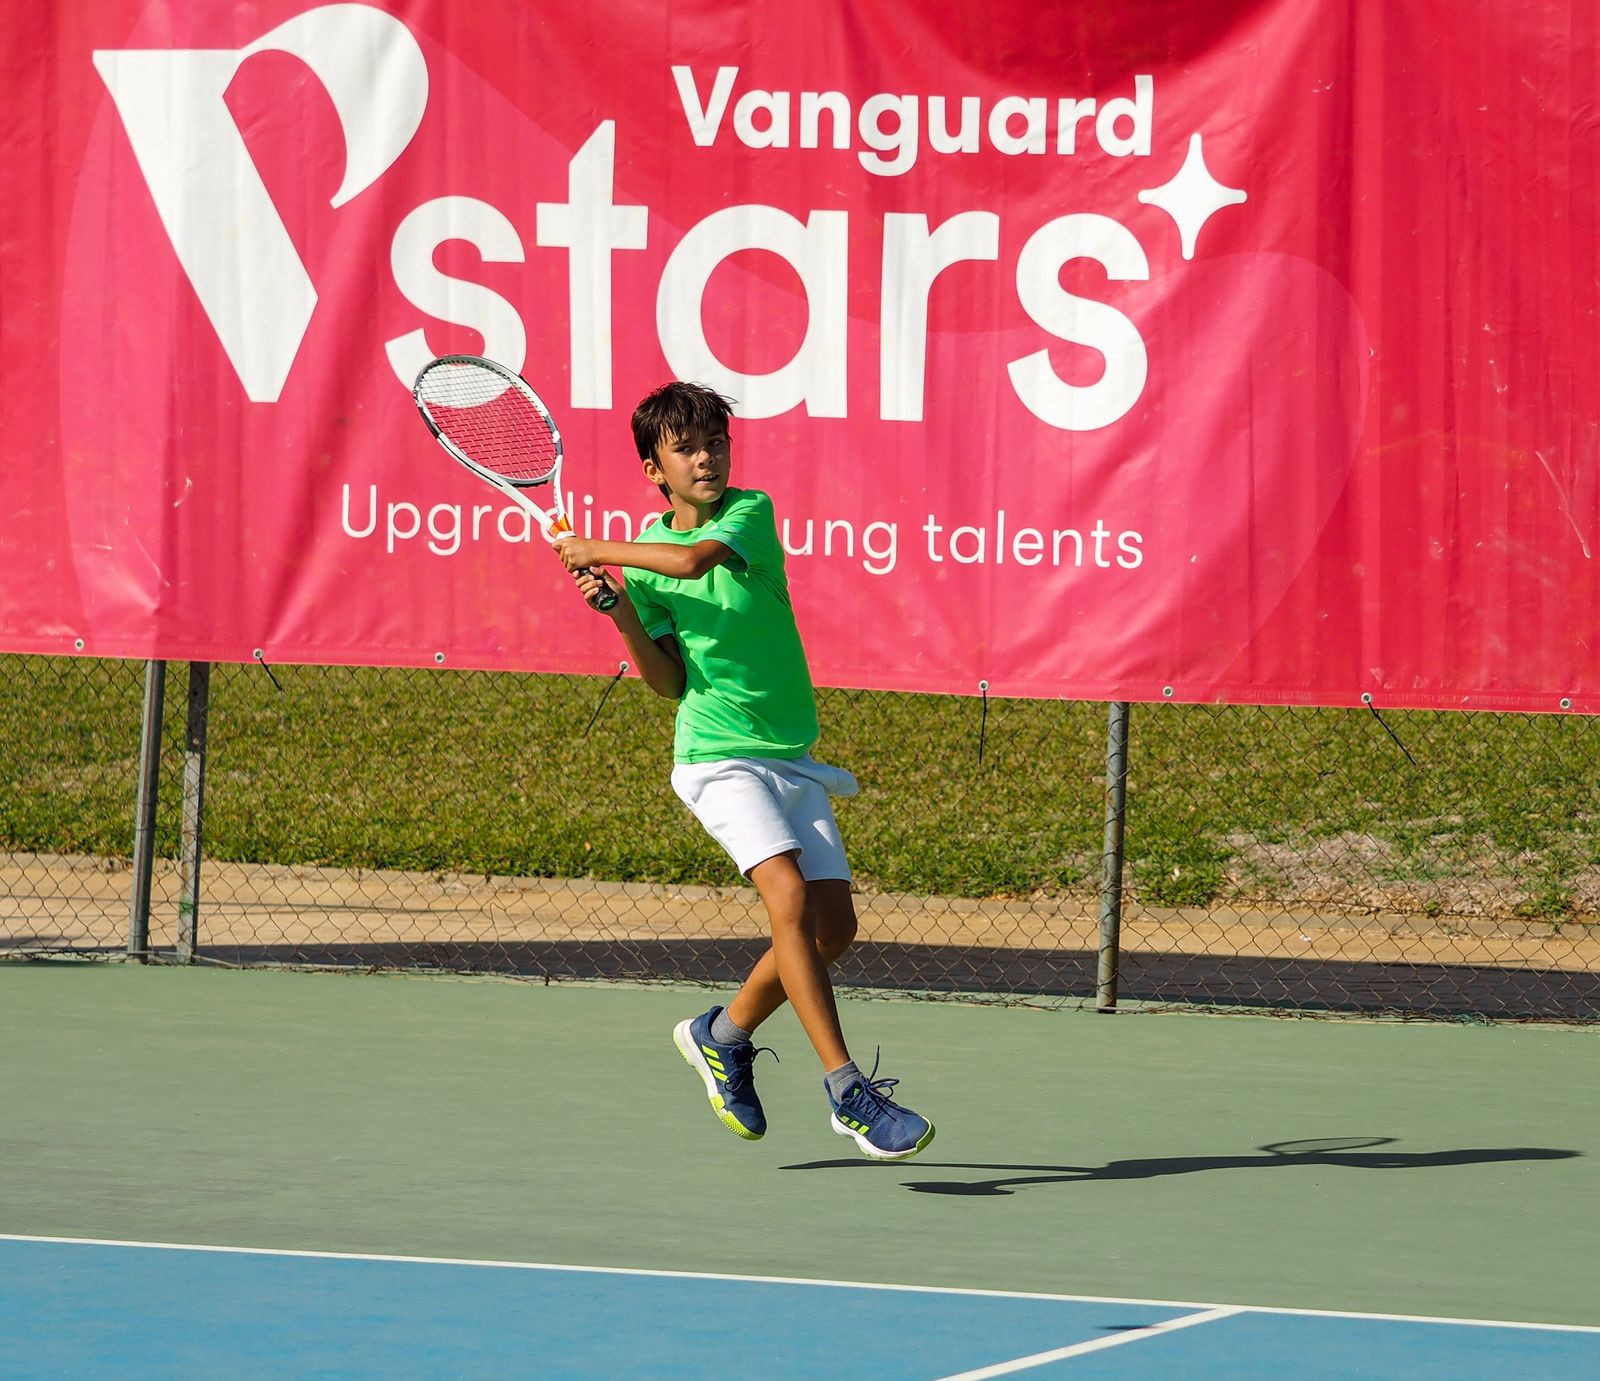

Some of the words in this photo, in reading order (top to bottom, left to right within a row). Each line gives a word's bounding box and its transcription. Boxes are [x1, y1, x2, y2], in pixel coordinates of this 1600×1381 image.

[671, 65, 1154, 177] Vanguard
[341, 483, 663, 556] Upgradin
[782, 518, 898, 576] ung
[922, 509, 1143, 569] talents
